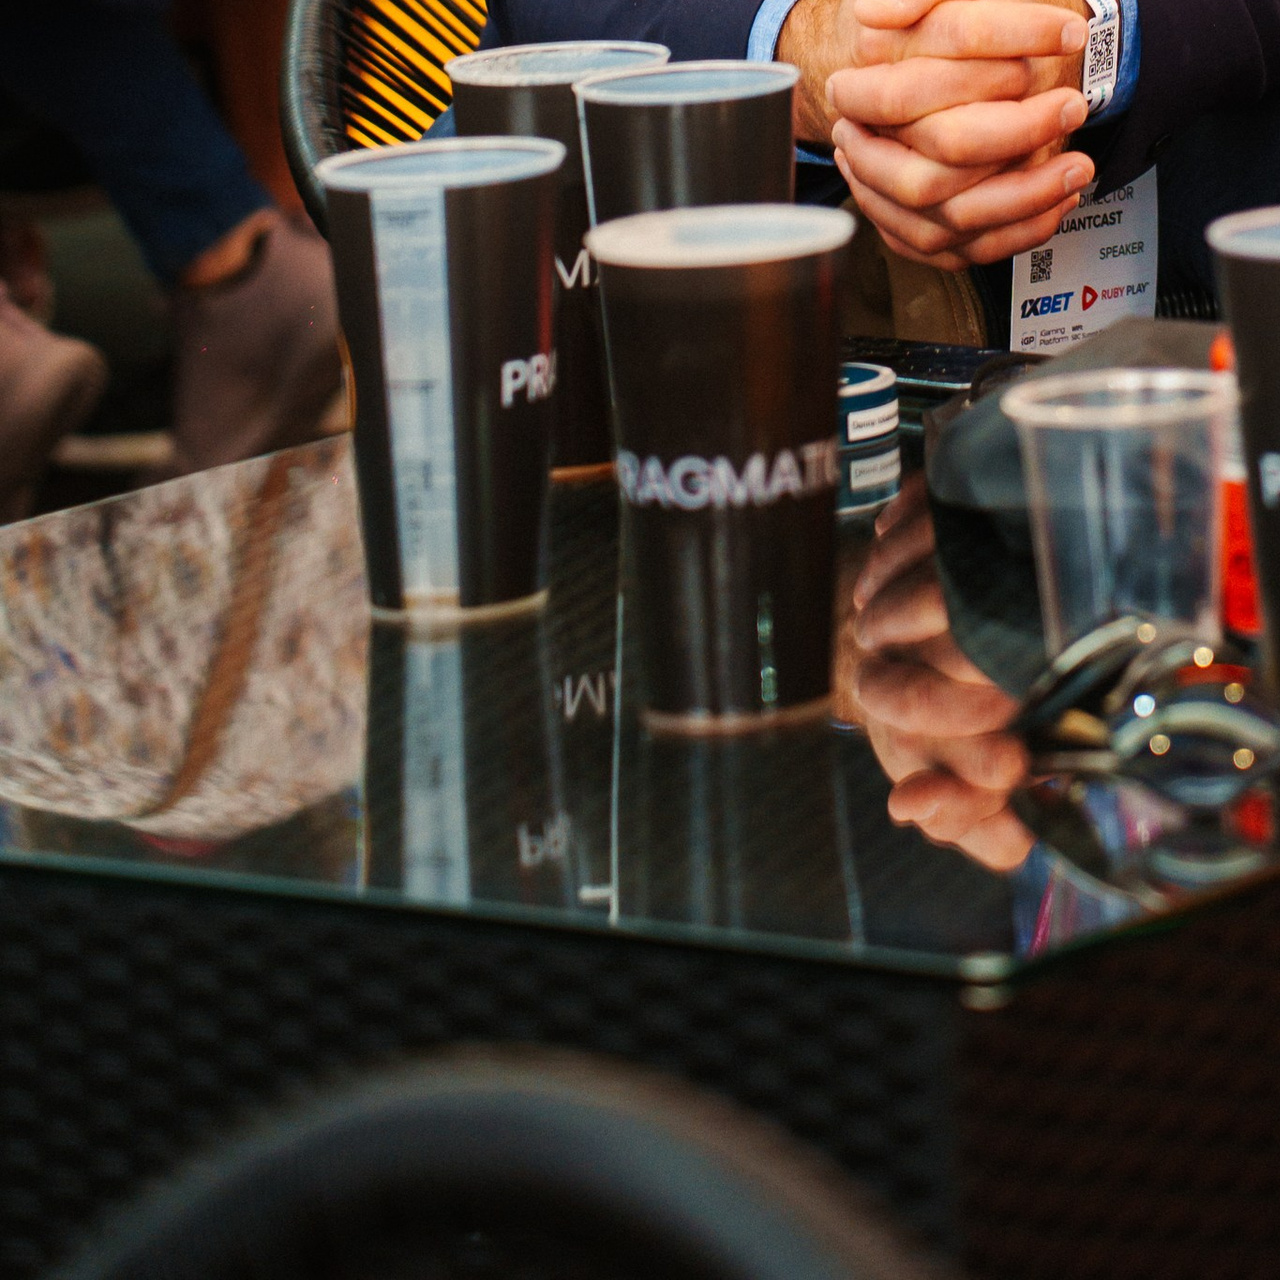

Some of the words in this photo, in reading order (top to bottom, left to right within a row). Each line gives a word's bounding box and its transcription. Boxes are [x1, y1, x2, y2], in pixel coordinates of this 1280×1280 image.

[1056, 210, 1123, 234] UANTCAST
[1099, 241, 1145, 260] SPEAKER
[1101, 287, 1125, 300] RUBY
[1020, 292, 1074, 319] 1XBET
